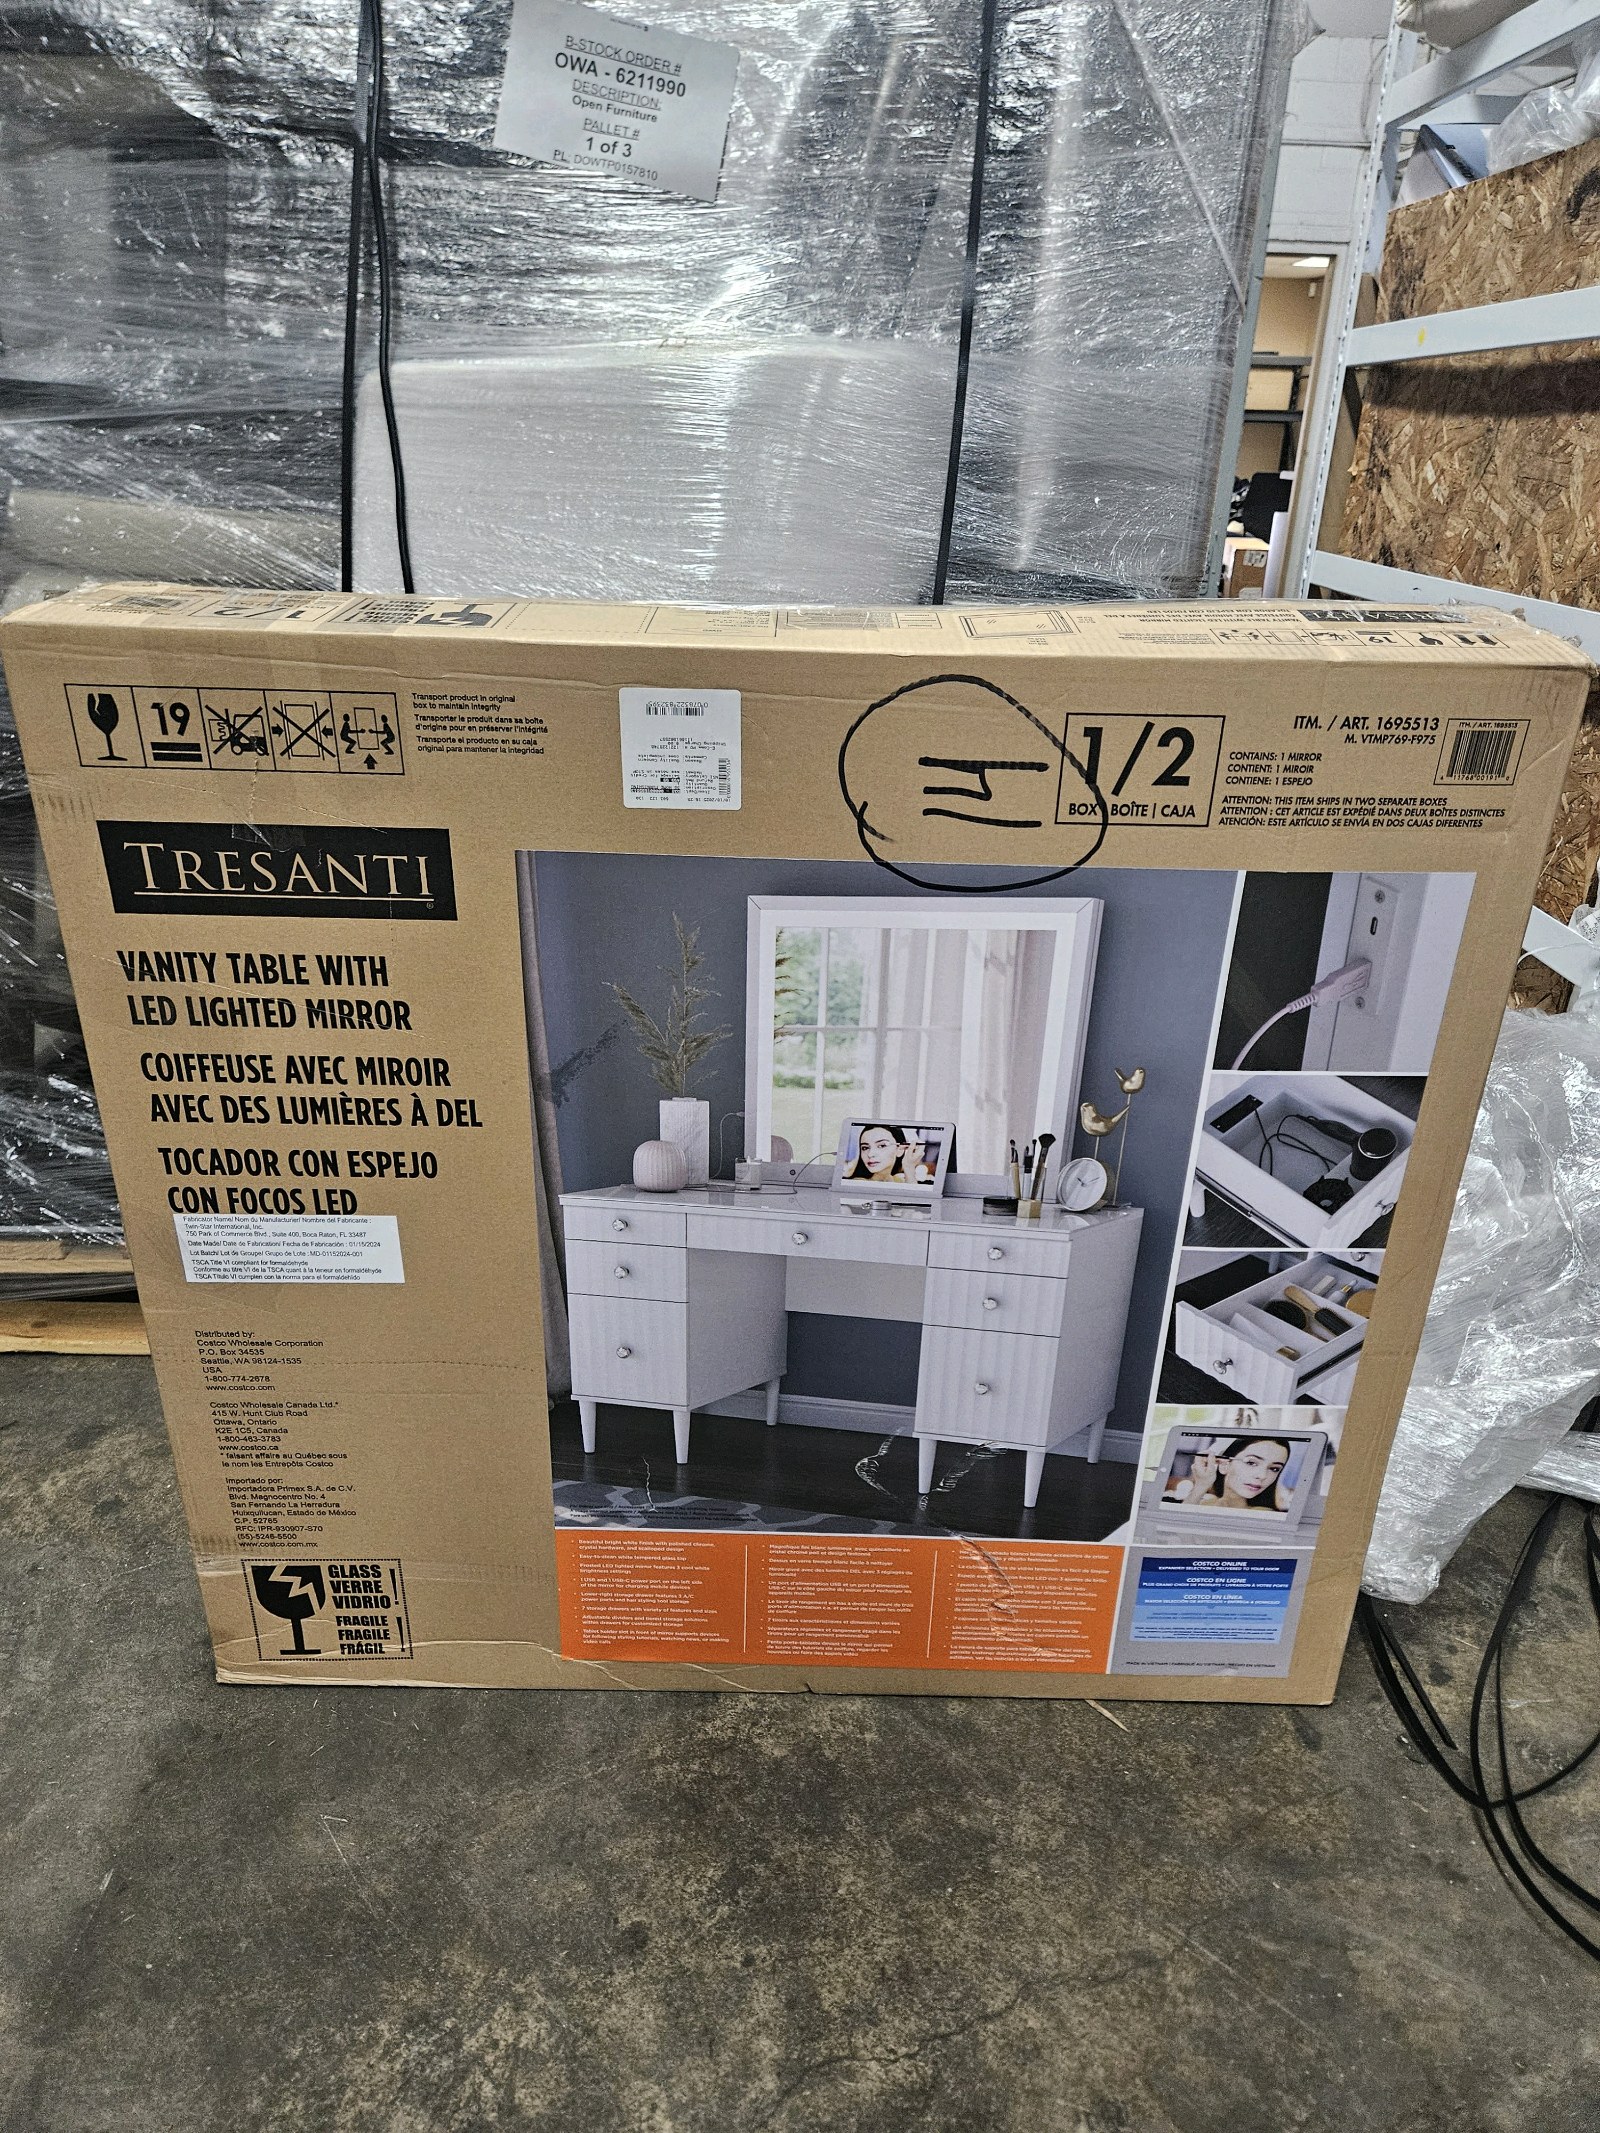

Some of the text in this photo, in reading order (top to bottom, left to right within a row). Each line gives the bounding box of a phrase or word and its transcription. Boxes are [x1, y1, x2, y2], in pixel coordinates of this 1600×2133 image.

[565, 36, 682, 74] B-STOCK ORDER #
[556, 52, 597, 77] OWA
[616, 68, 685, 99] 6211990
[572, 79, 661, 109] DESCRIPTION:
[572, 95, 660, 122] Open Furniture
[584, 118, 640, 139] PALLET #
[587, 137, 631, 157] 1 of 3
[574, 154, 660, 182] DOWTP0157810
[412, 693, 448, 701] Transport
[489, 695, 515, 703] original
[471, 703, 500, 712] integrity
[151, 702, 190, 736] 19
[414, 714, 457, 722] Transporter
[1294, 716, 1322, 729] ITM.
[1340, 716, 1369, 730] ART.
[1378, 717, 1439, 731] 1695513
[416, 723, 447, 732] d'origine
[479, 725, 513, 733] préserver
[416, 736, 456, 744] Transporte
[522, 738, 537, 746] caja
[1344, 734, 1436, 744] M. VTMP769-F975
[418, 745, 444, 753] original
[508, 747, 544, 755] integridad
[1230, 752, 1277, 761] CONTAINS:
[1288, 753, 1322, 761] MIRROR
[1084, 721, 1195, 796] 1/2
[1228, 764, 1272, 773] CONTIENT:
[1283, 765, 1314, 773] MIROIR
[1226, 776, 1271, 785] CONTIENE:
[1282, 777, 1313, 785] ESPEJO
[1222, 796, 1447, 806] ATTENTION: THIS ITEM SHIPS IN TWO SEPARATE BOXES
[1069, 804, 1098, 816] BOX
[1111, 801, 1148, 816] BOÎTE
[1161, 805, 1195, 817] CAJA
[1220, 807, 1267, 815] ATTENTION
[1275, 808, 1291, 816] CET
[1292, 808, 1325, 816] ARTICLE
[1327, 808, 1341, 816] EST
[1343, 807, 1375, 816] EXPÉDIÉ
[1378, 809, 1402, 817] DANS
[1404, 809, 1428, 817] DEUX
[1429, 807, 1458, 817] BOÎTES
[1459, 809, 1505, 817] DISTINCTES
[1219, 816, 1265, 826] ATENCIÓN:
[1289, 817, 1329, 826] ARTÍCULO
[1343, 818, 1369, 827] ENVÍA
[1372, 819, 1385, 827] EN
[1386, 819, 1405, 827] DOS
[1407, 819, 1434, 827] CAJAS
[1436, 820, 1483, 828] DIFERENTES
[123, 842, 433, 896] TRESANTI
[116, 951, 388, 986] VANITY TABLE WITH
[127, 995, 412, 1030] LED LIGHTED MIRROR
[141, 1053, 451, 1086] COIFFEUSE AVEC MIROIR
[151, 1091, 483, 1127] AVEC DES LUMIÈRES À DEL
[157, 1148, 437, 1178] TOCADOR CON ESPEJO
[168, 1187, 358, 1215] CON FOCOS LED
[275, 1340, 323, 1348] Corporation
[328, 1565, 381, 1578] GLASS
[329, 1580, 383, 1593] VERRE
[332, 1595, 391, 1609] VIDRIO
[336, 1616, 388, 1626] FRAGILE
[338, 1629, 390, 1640] FRAGILE
[340, 1641, 385, 1654] FRÁGIL
